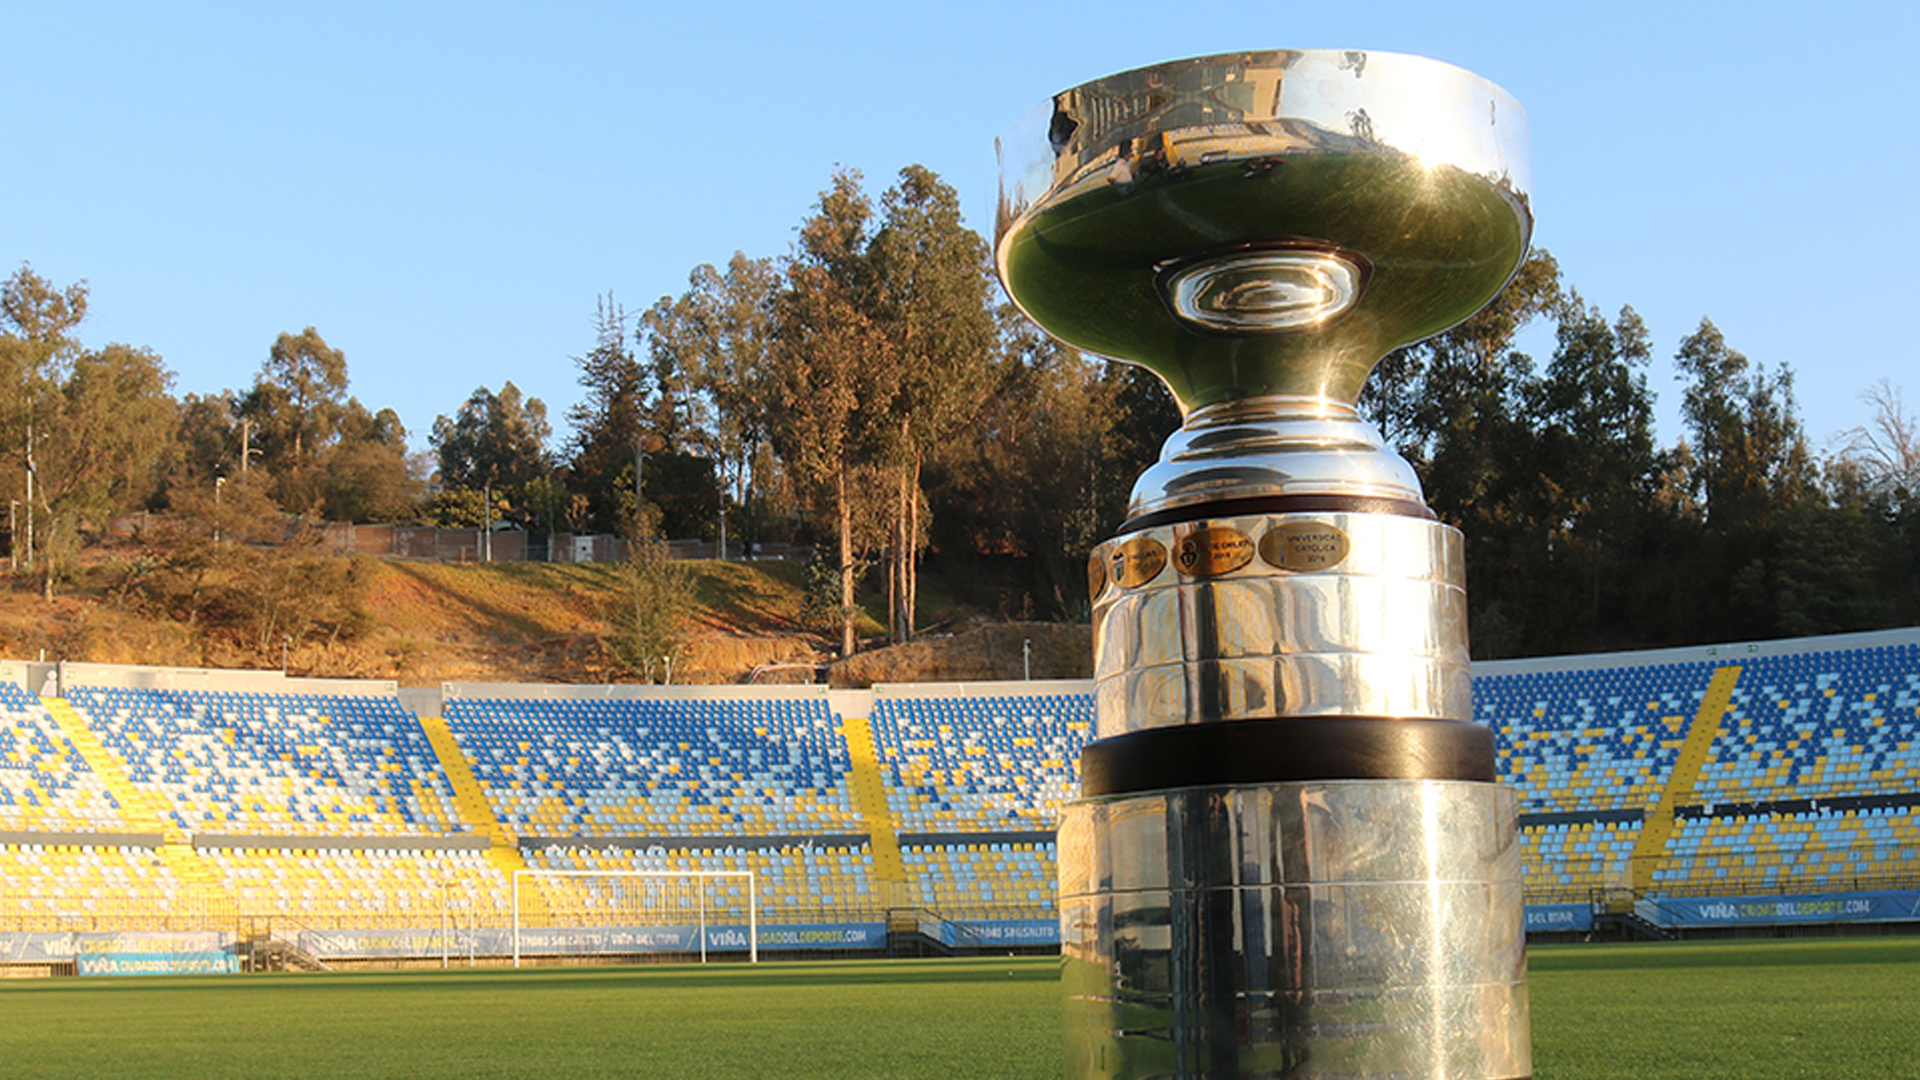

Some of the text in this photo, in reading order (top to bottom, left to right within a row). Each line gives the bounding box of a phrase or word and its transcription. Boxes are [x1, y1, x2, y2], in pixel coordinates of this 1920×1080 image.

[1699, 902, 1738, 918] VIÑA
[709, 930, 867, 946] VIÑA CUDADDELDEPORTE.COM
